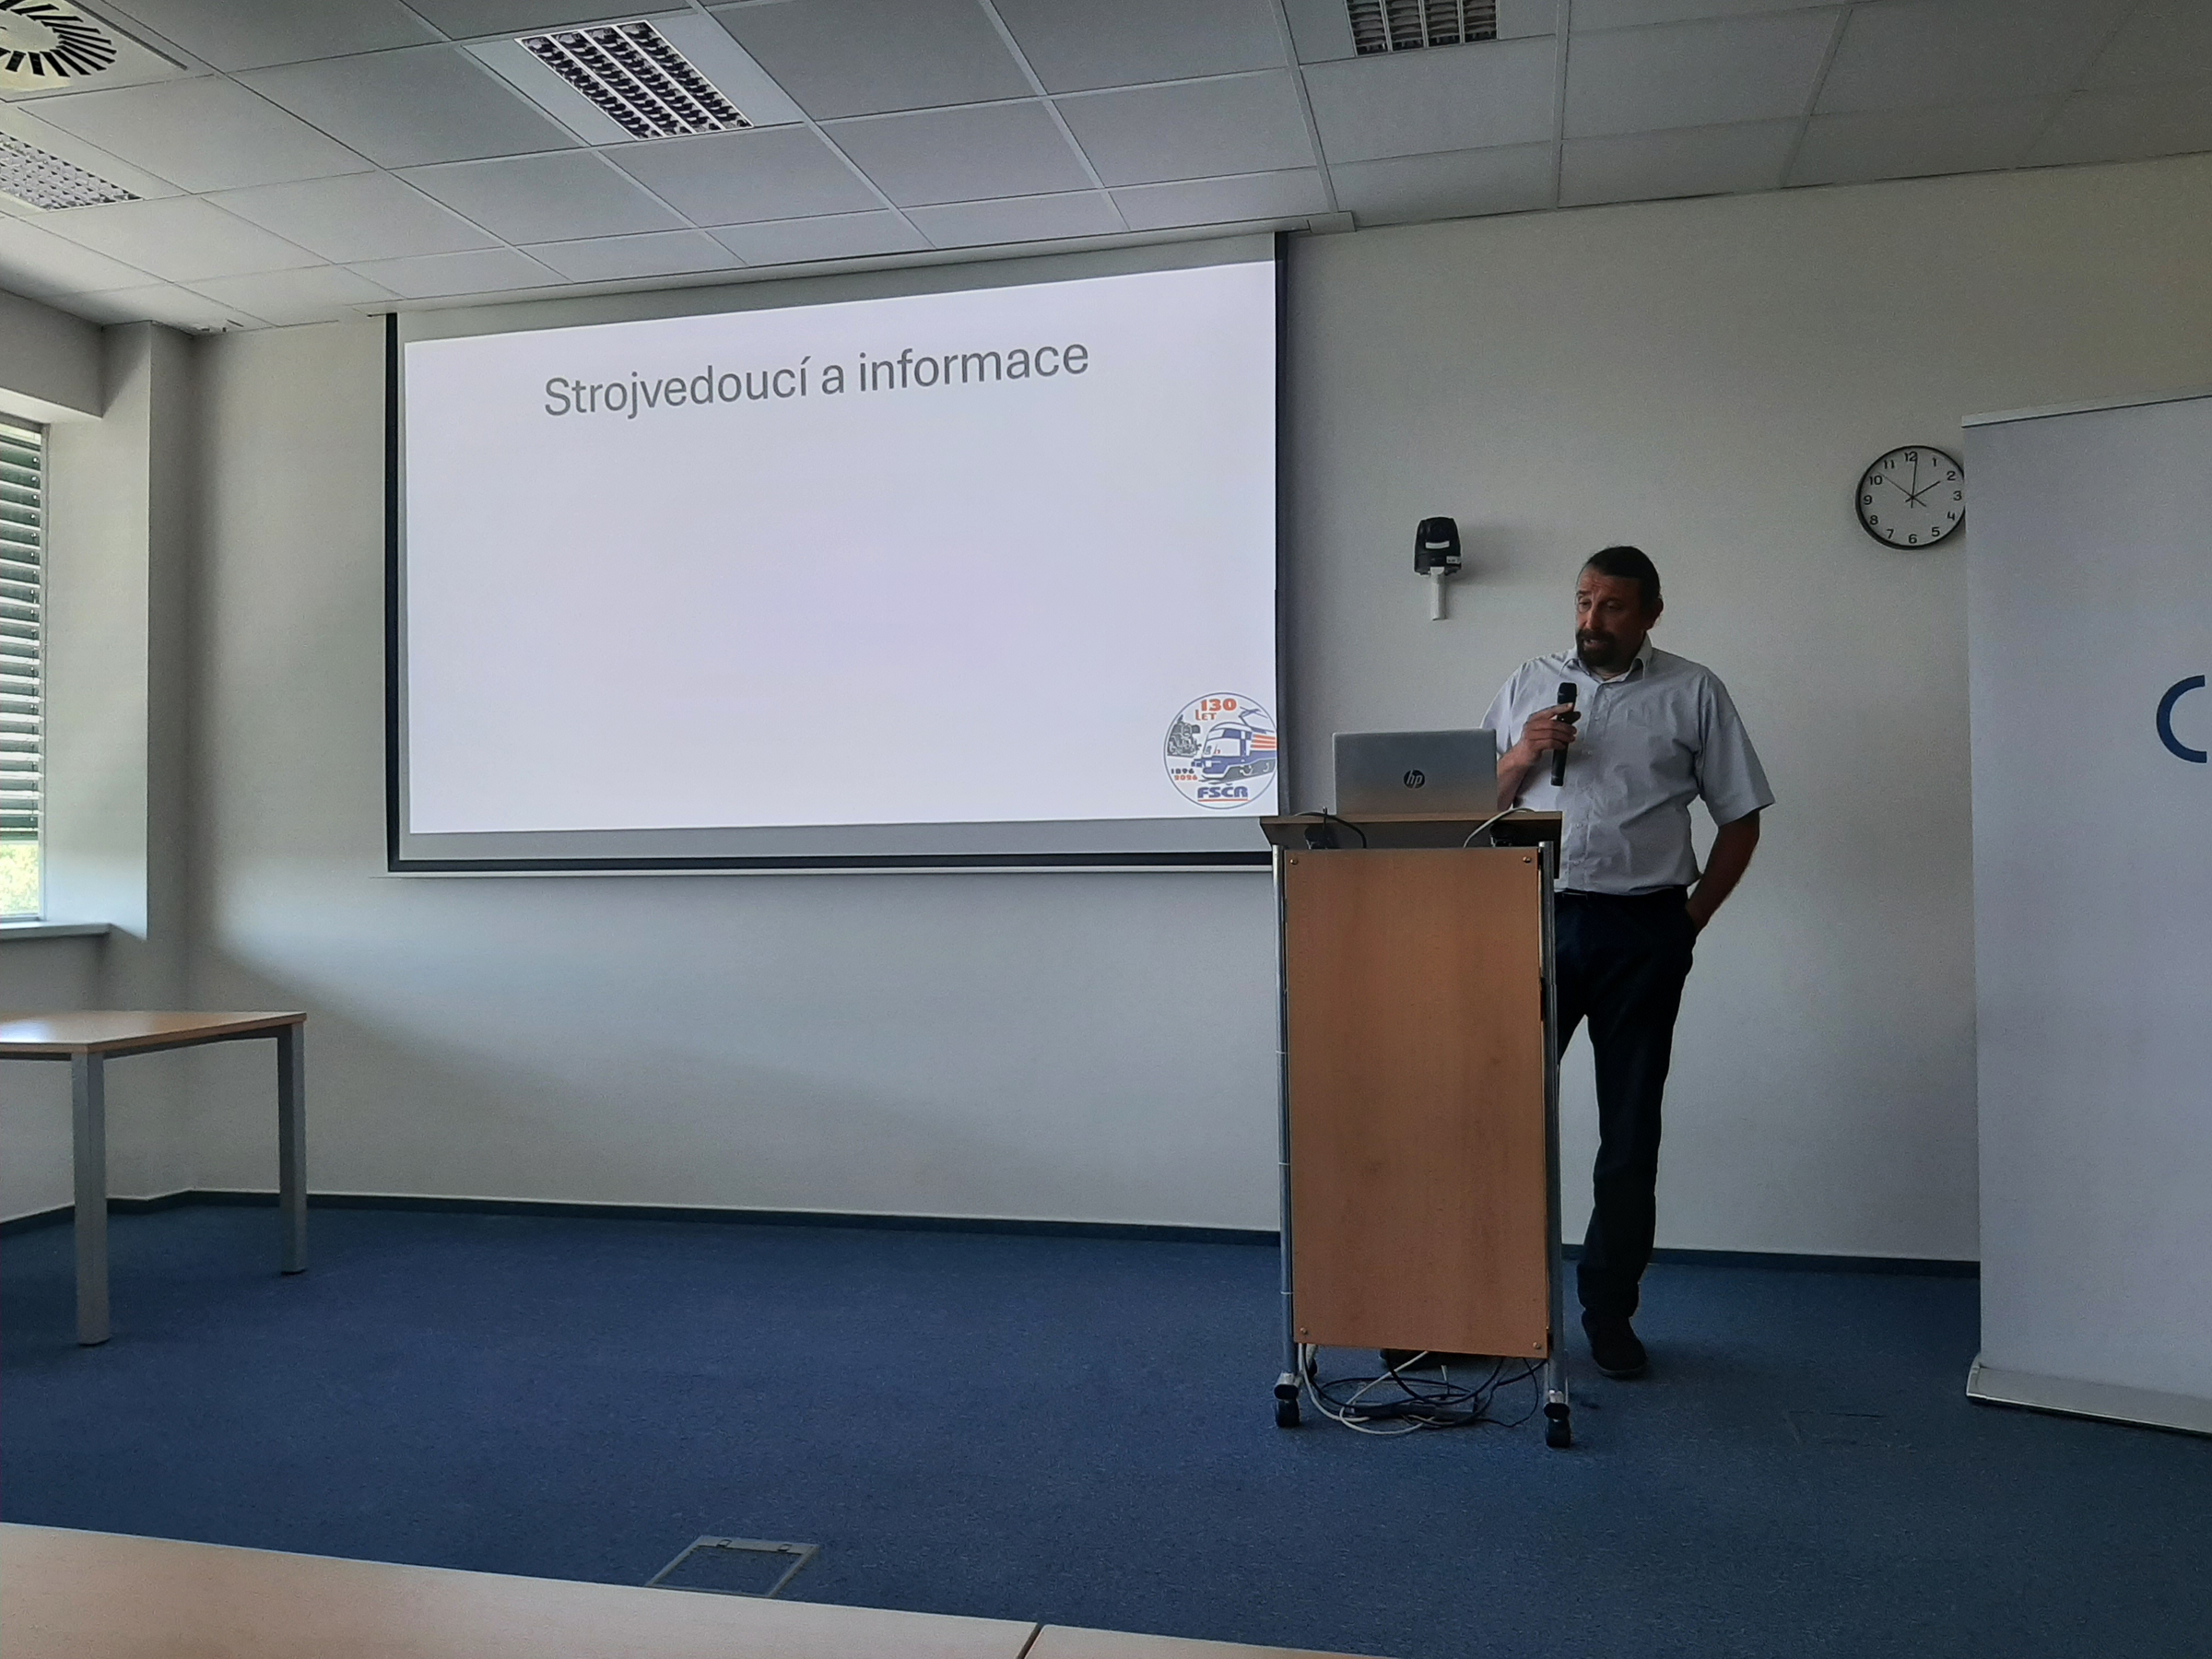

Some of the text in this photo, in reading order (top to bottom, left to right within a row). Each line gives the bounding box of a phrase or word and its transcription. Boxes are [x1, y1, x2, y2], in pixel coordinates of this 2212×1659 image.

[545, 343, 1089, 419] Strojvedoucí a informace
[1904, 451, 1918, 463] 12
[1932, 457, 1937, 467] 1
[1883, 460, 1895, 469] 11
[1869, 475, 1883, 486] 10
[1947, 470, 1957, 481] 2
[1863, 495, 1873, 505] 9
[1953, 490, 1962, 501] 3
[1869, 515, 1879, 525] 8
[1947, 511, 1956, 521] 4
[1886, 528, 1895, 539] 7
[1931, 526, 1940, 537] 5
[1908, 534, 1918, 544] 6
[1200, 698, 1237, 712] 130
[1406, 769, 1424, 789] hp
